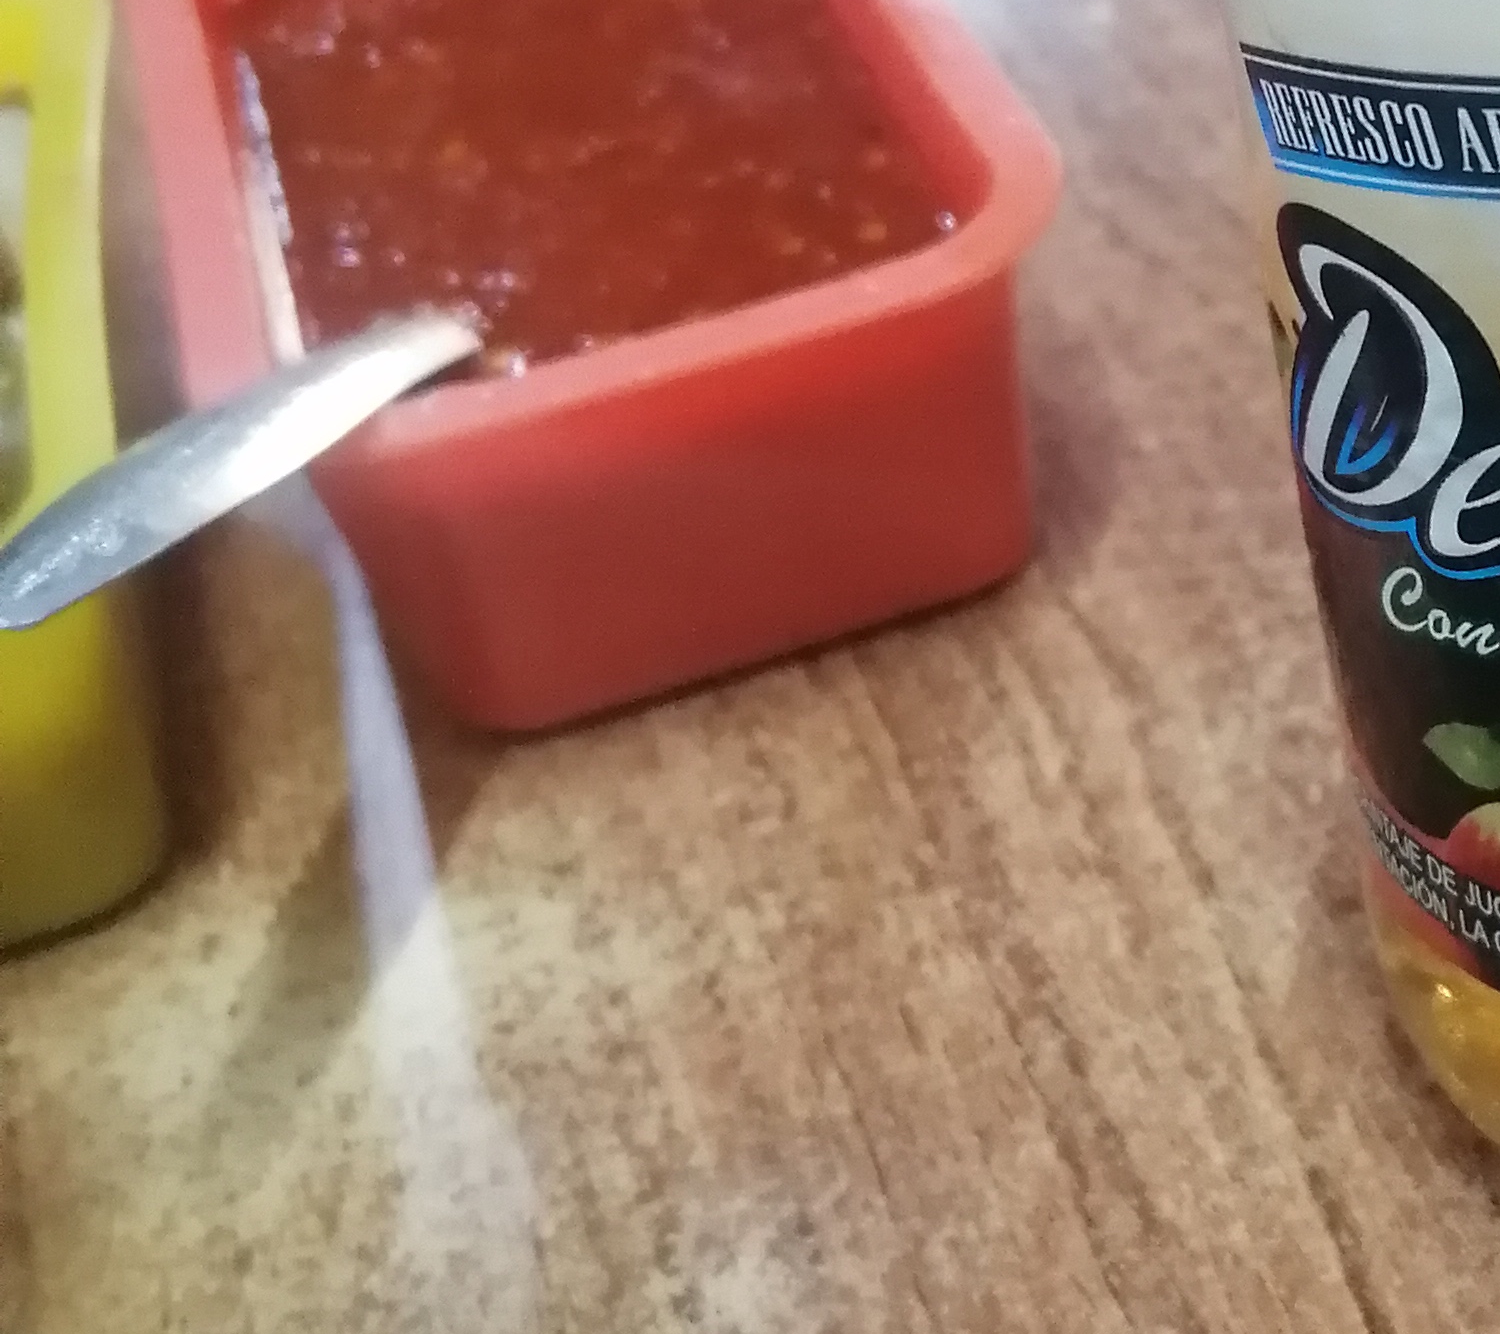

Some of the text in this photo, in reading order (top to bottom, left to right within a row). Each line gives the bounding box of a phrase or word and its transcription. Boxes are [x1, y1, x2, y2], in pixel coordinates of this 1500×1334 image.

[1258, 78, 1445, 172] REFRESCO
[1381, 566, 1500, 655] Con
[1426, 854, 1458, 897] DE
[1459, 908, 1491, 950] LA
